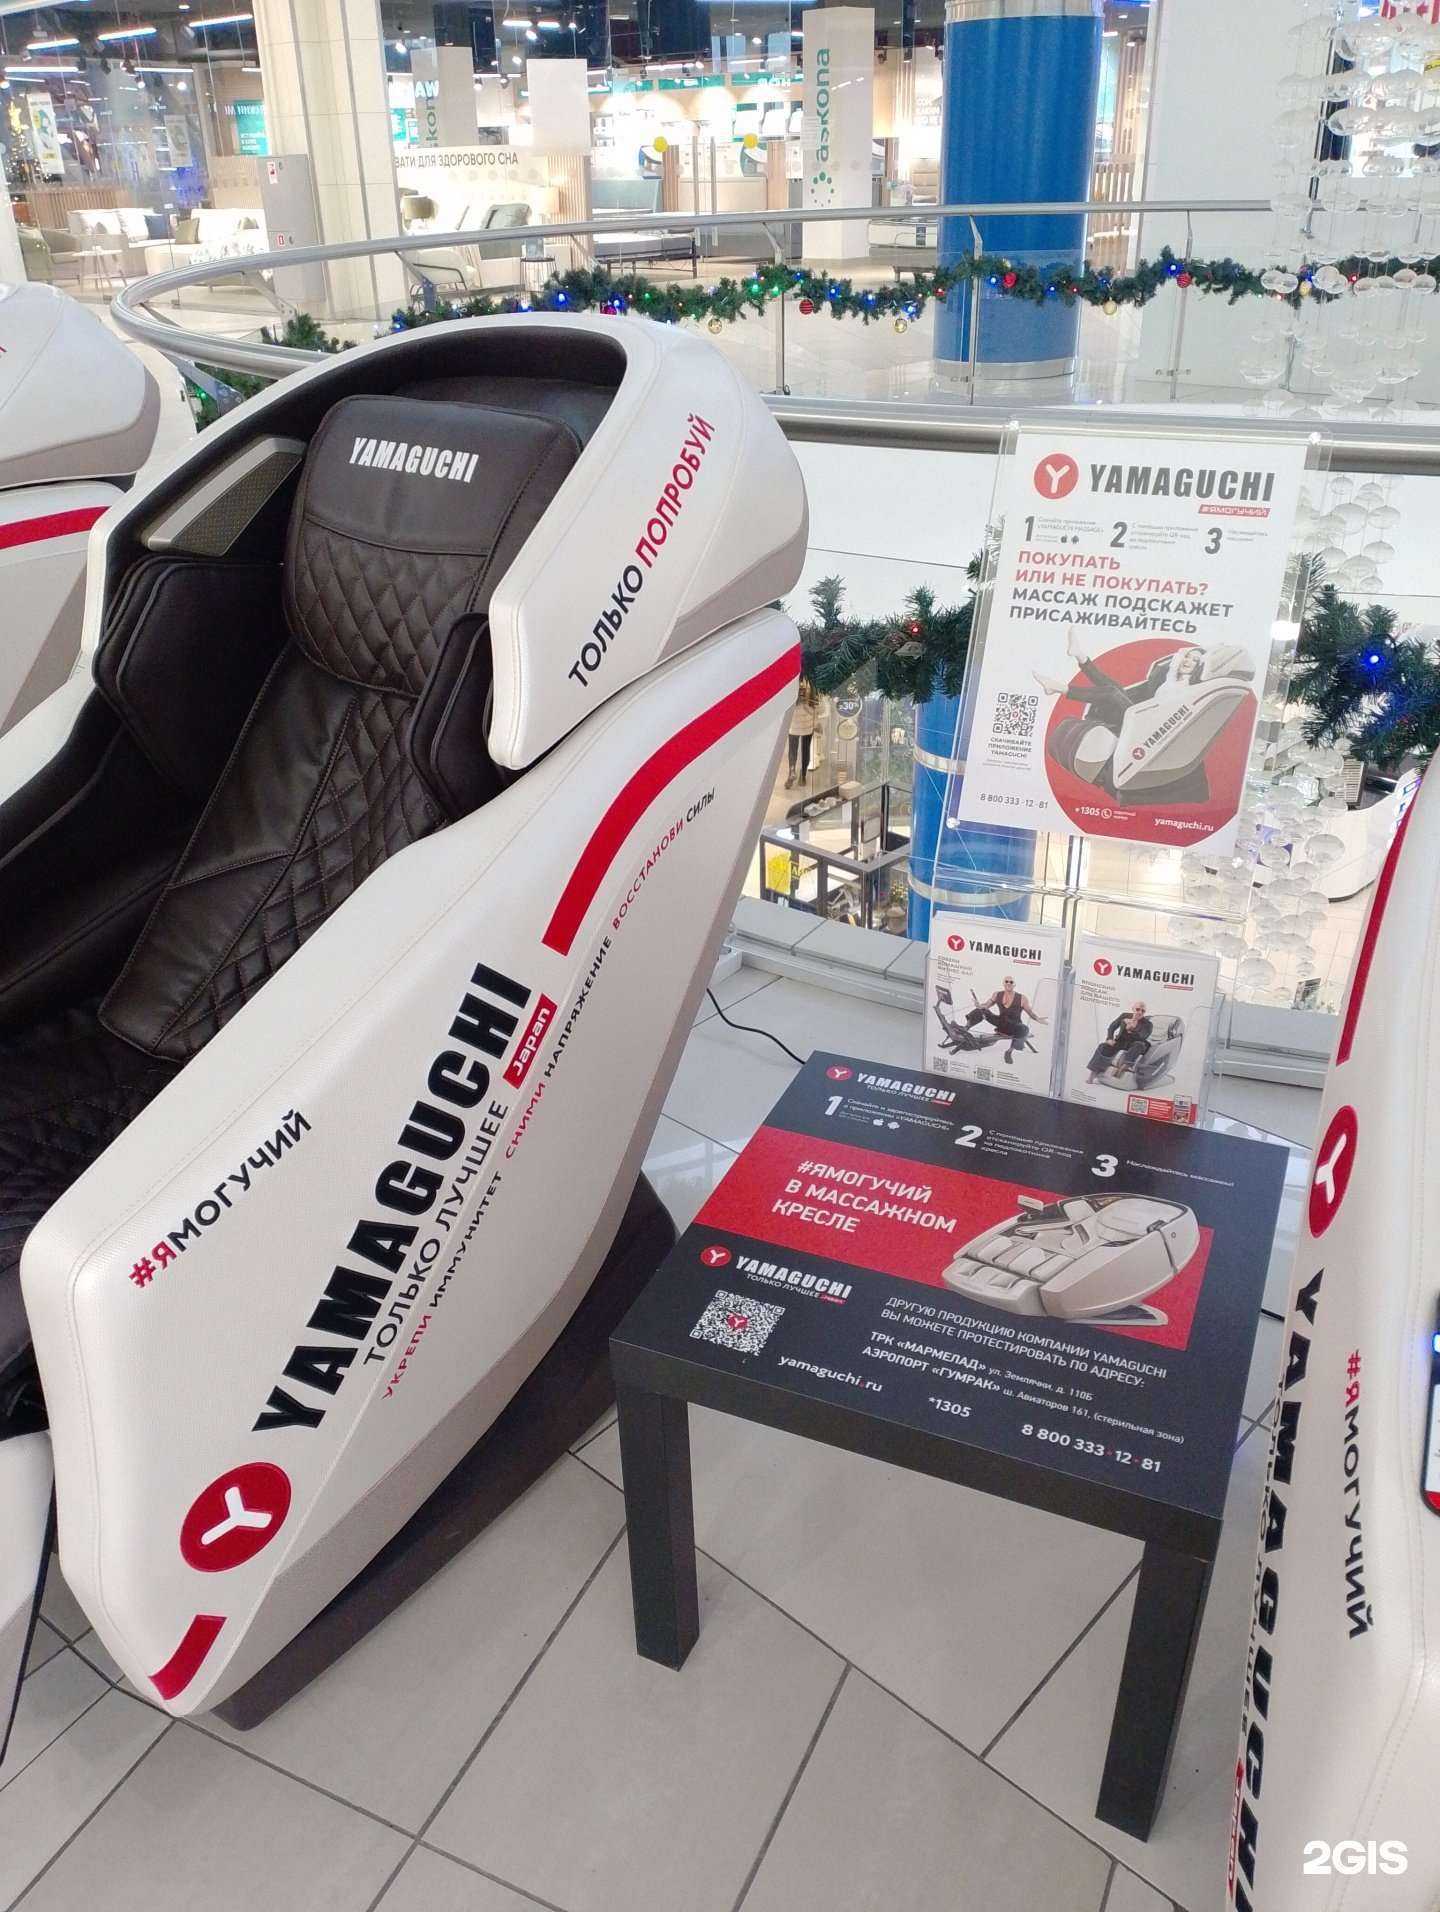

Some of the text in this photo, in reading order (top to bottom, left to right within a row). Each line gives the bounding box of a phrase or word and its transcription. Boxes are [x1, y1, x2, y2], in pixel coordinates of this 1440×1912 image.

[816, 48, 830, 162] askona
[418, 154, 436, 168] ДЛЯ
[439, 153, 496, 168] ЗДОРОВОГО
[497, 152, 518, 165] СНА
[349, 437, 479, 483] YAMAGUCHI
[1090, 463, 1275, 502] YAMAGUCHI
[1025, 516, 1035, 541] 1
[1110, 521, 1128, 548] 2
[1204, 527, 1223, 554] 3
[568, 412, 716, 687] ТОЛЬКО ПОПРОБУЙ
[1018, 550, 1120, 570] ПОКУПАТЬ
[1015, 568, 1208, 597] ИЛИ НЕ ПОКУПАТЬ?
[1009, 606, 1197, 635] ПРИСАЖИВАЙТЕСЬ
[1012, 587, 1234, 619] МАССАЖ ПОДСКАЖЕТ
[1143, 704, 1190, 749] YAMAGUCHI
[980, 793, 986, 801] 8
[987, 794, 1003, 803] 800
[1005, 796, 1020, 806] 333
[1154, 817, 1214, 832] yamaguchi.ru
[969, 940, 1042, 961] YAMAGUCHI
[1116, 964, 1195, 985] YAMAGUCHI
[513, 1007, 550, 1076] Japan
[382, 788, 715, 1399] УКРЕПИ ИММУНИТЕТ СНИМИ НАПРЯЖЕНИЕ ВОССТАНОВИ СИЛЫ
[857, 1072, 956, 1102] YAMAGUCHI
[825, 1095, 843, 1116] 1
[954, 1124, 982, 1148] 2
[797, 1160, 932, 1203] #ЯМОГУЧИЙ
[1091, 1154, 1118, 1177] 3
[128, 1108, 312, 1288] #ЯМОГУЧИЙ
[251, 963, 531, 1431] YAMAGUCHI
[785, 1179, 957, 1233] В МАССАЖНОМ
[364, 1100, 508, 1365] ТОЛЬКО ЛУЧШЕЕ
[772, 1199, 860, 1233] КРЕСЛЕ
[736, 1255, 852, 1299] YAMAGUCHI
[746, 1273, 820, 1298] ТОЛЬКО ЛУЧШЕЕ
[881, 1308, 1145, 1388] ВЫ МОЖЕТЕ ПРОТЕСТИРОВАТЬ ПО АДРЕСУ:
[885, 1297, 1167, 1379] ДРУГУЮ ПРОДУКЦИЮ КОМПАНИИ YAMAGUCHI
[778, 1356, 883, 1392] yamaguchi.ru
[870, 1331, 895, 1346] ТРК
[897, 1340, 987, 1372] «МАРМЕЛАД»
[1069, 1388, 1093, 1402] 110Б
[862, 1346, 930, 1372] АЭРОПОРТ
[932, 1366, 1000, 1392] «ГУМРАК»
[1017, 1391, 1069, 1412] Авиаторов
[1094, 1412, 1154, 1436] (стерильная
[1157, 1430, 1185, 1445] зона)
[1021, 1423, 1034, 1436] 8
[1036, 1427, 1070, 1447] 800
[1073, 1438, 1105, 1457] 333
[1344, 1350, 1374, 1639] #ЯМОГУЧИЙ
[1233, 1268, 1325, 1912] YAMAGUCHI
